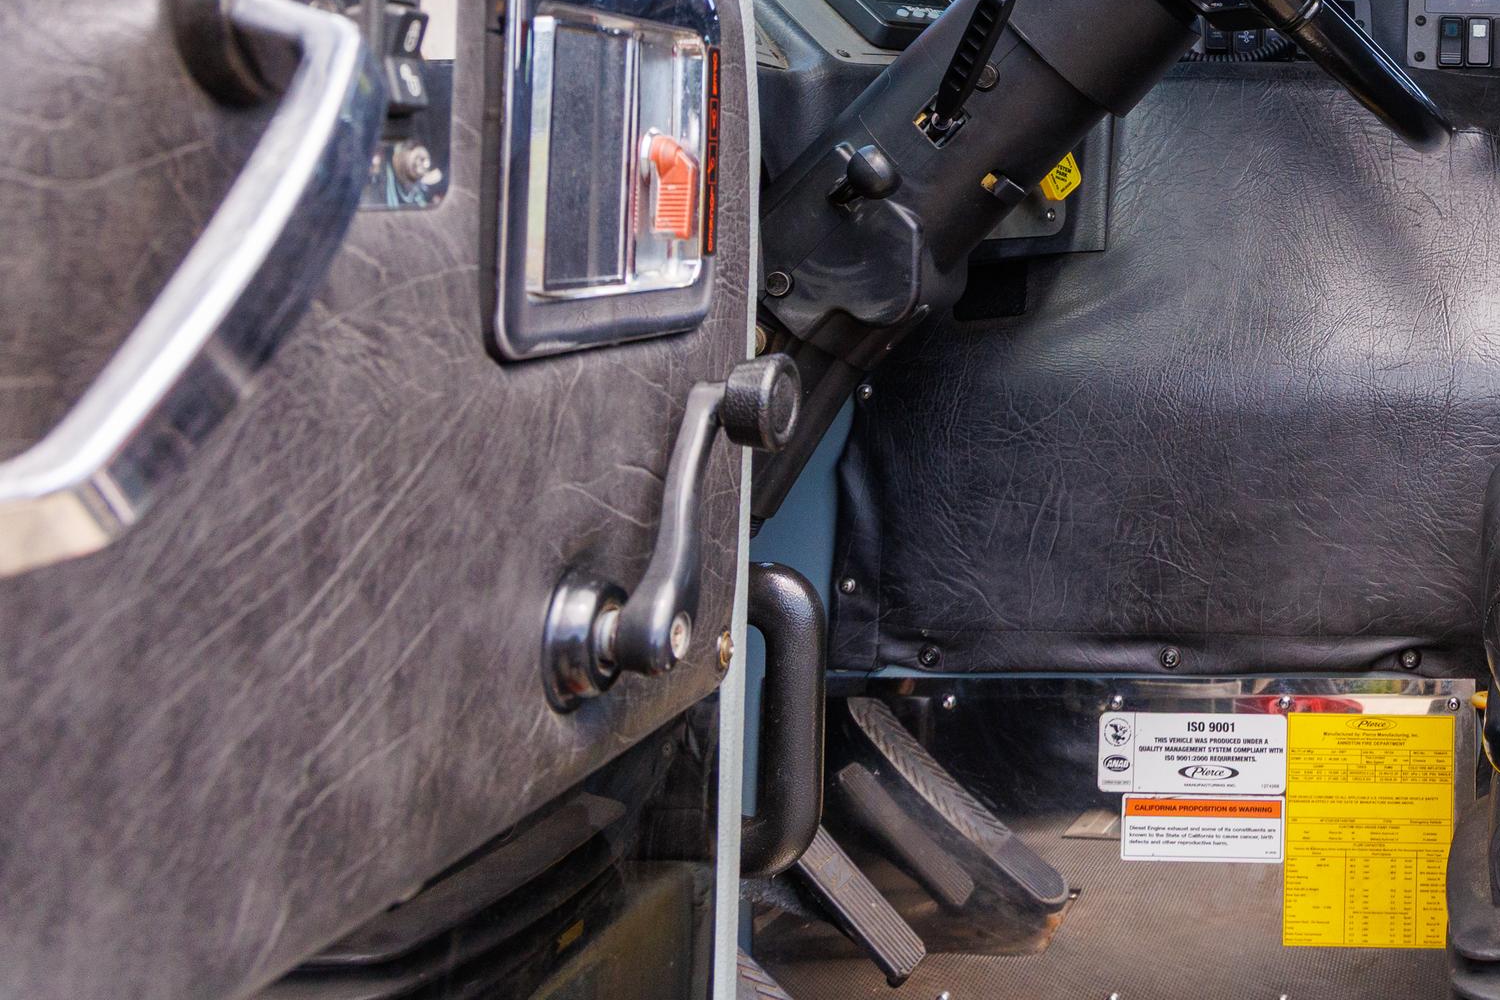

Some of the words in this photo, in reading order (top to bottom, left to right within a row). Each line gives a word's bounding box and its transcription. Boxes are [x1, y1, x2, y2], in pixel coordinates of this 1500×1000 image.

[1187, 722, 1205, 732] ISO
[1208, 722, 1236, 732] 9001
[1358, 720, 1386, 729] Pierce
[1191, 766, 1225, 778] Pierce
